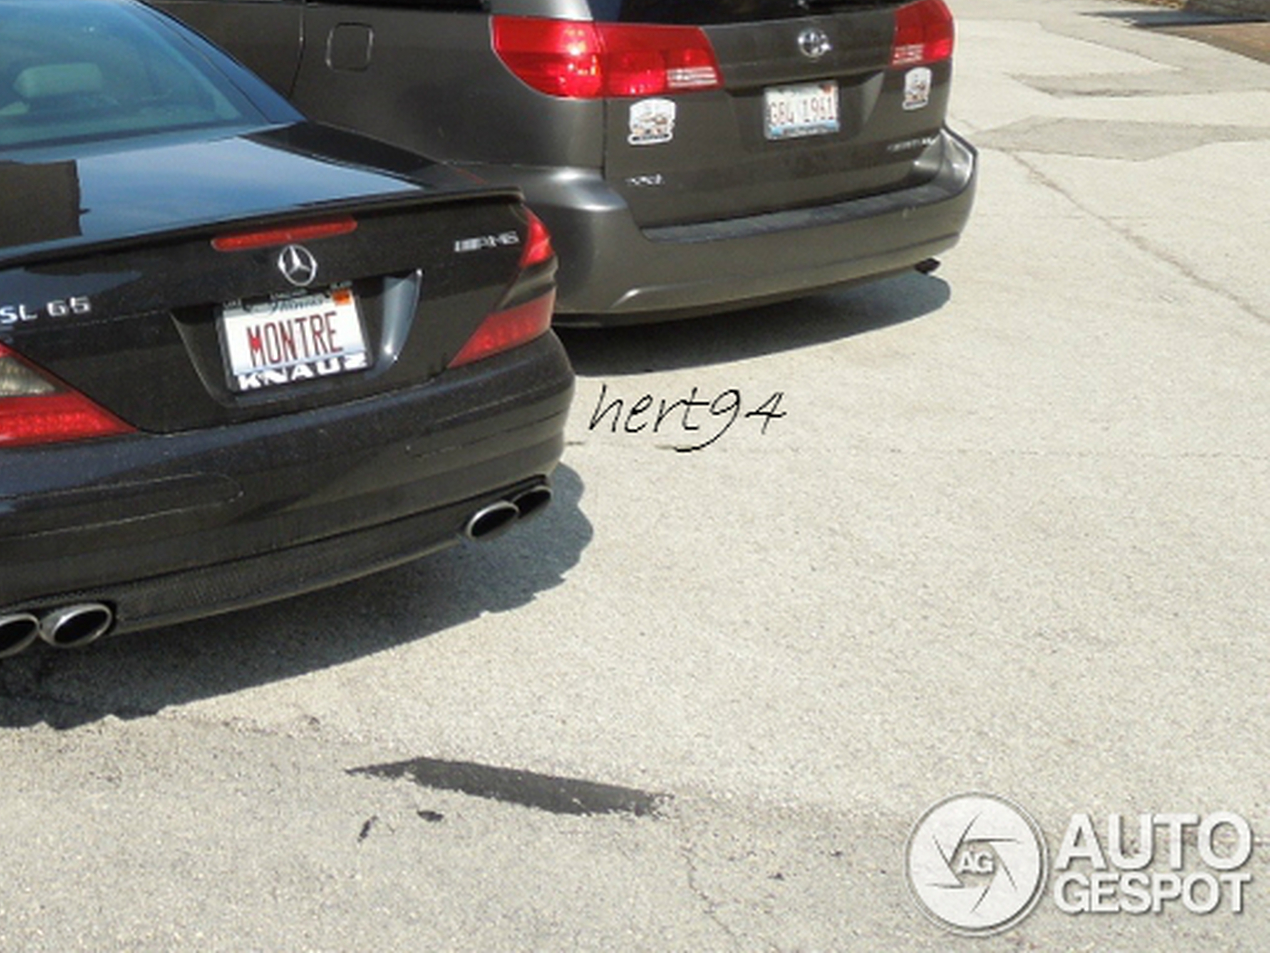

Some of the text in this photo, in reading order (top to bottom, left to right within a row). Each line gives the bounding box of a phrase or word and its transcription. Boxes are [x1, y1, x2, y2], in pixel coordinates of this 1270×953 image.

[46, 296, 90, 317] 65
[246, 310, 343, 368] MONTRE
[237, 352, 368, 391] KNAUZ
